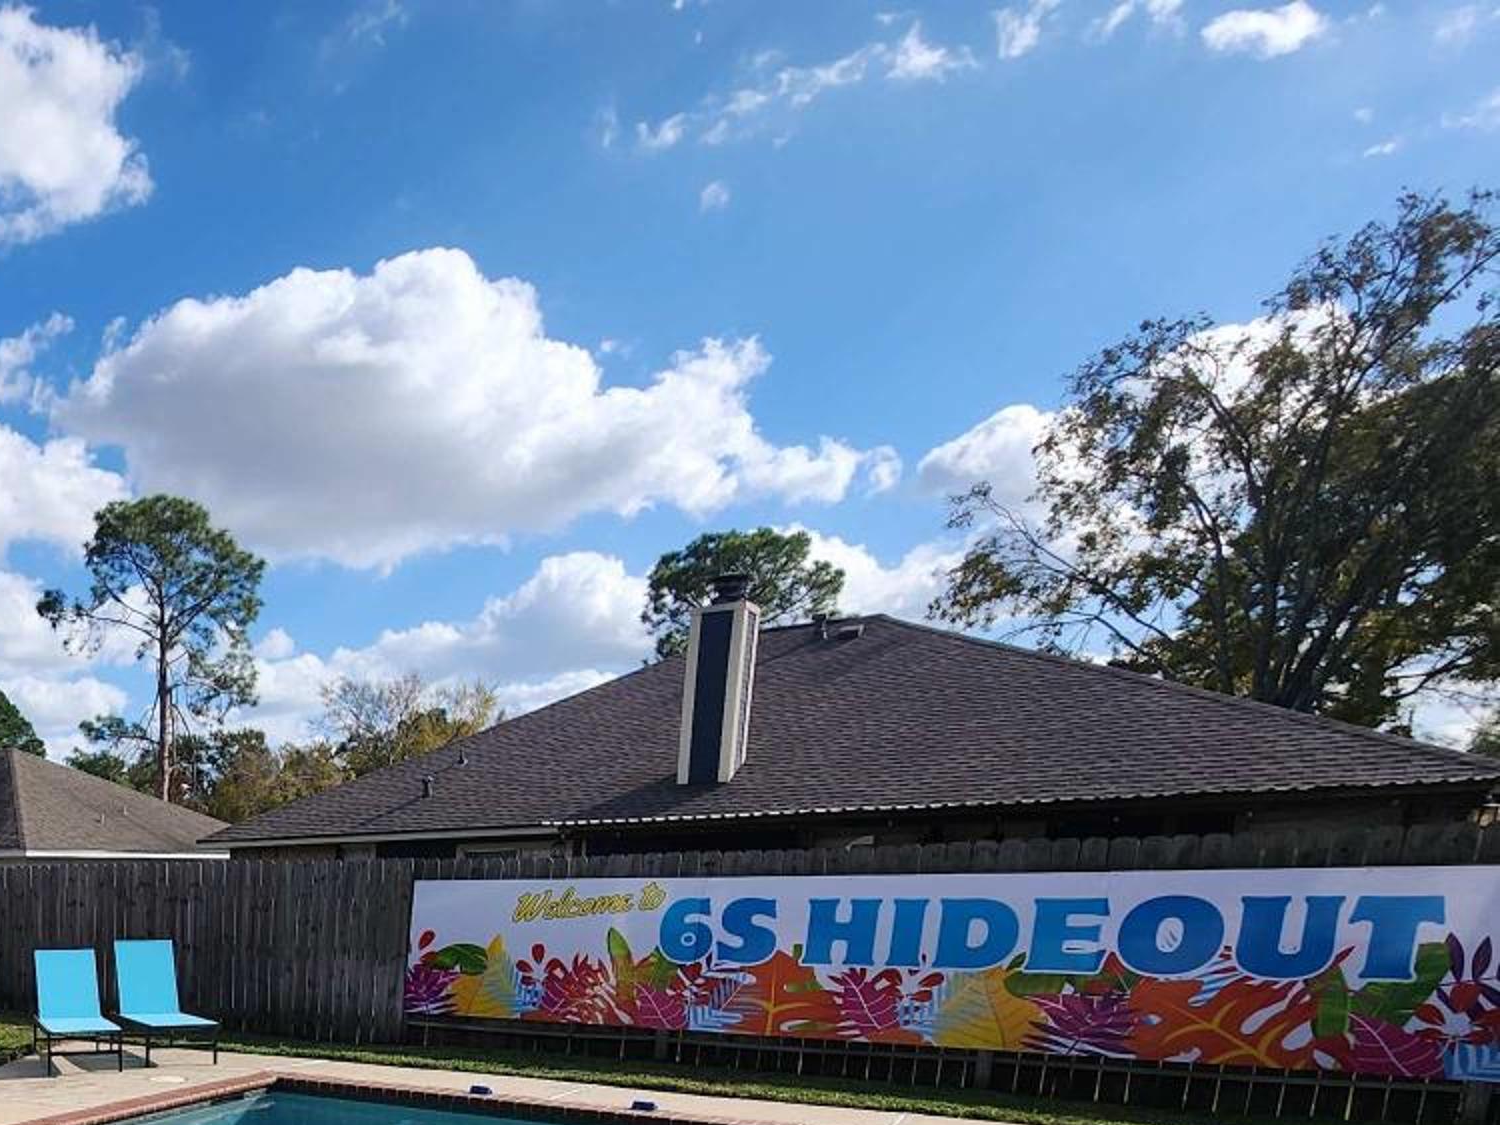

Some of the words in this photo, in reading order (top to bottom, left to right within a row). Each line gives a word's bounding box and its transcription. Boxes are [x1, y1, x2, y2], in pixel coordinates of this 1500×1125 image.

[512, 887, 633, 923] Welcome
[638, 881, 666, 911] to
[659, 896, 778, 964] 6S
[801, 895, 1447, 980] HIDEOUT
